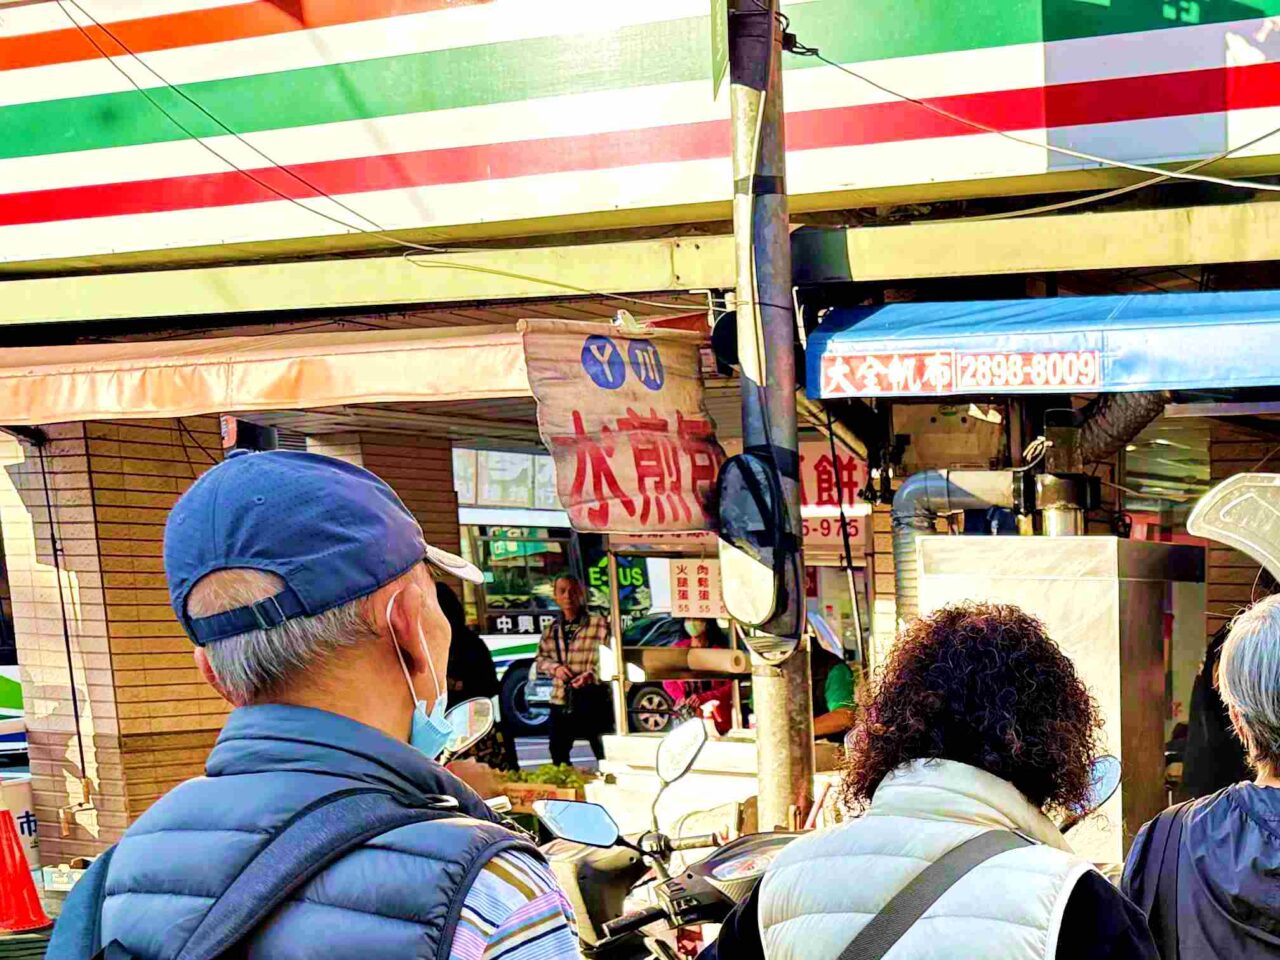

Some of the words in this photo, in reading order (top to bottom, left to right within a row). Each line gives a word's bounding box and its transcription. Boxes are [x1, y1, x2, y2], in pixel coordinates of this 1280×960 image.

[827, 353, 952, 394] 大全帆布
[961, 352, 1096, 387] 2898-8009
[550, 407, 722, 528] 水煎包
[799, 454, 859, 508] 餅
[588, 566, 644, 586] E-US
[17, 811, 38, 837] 市
